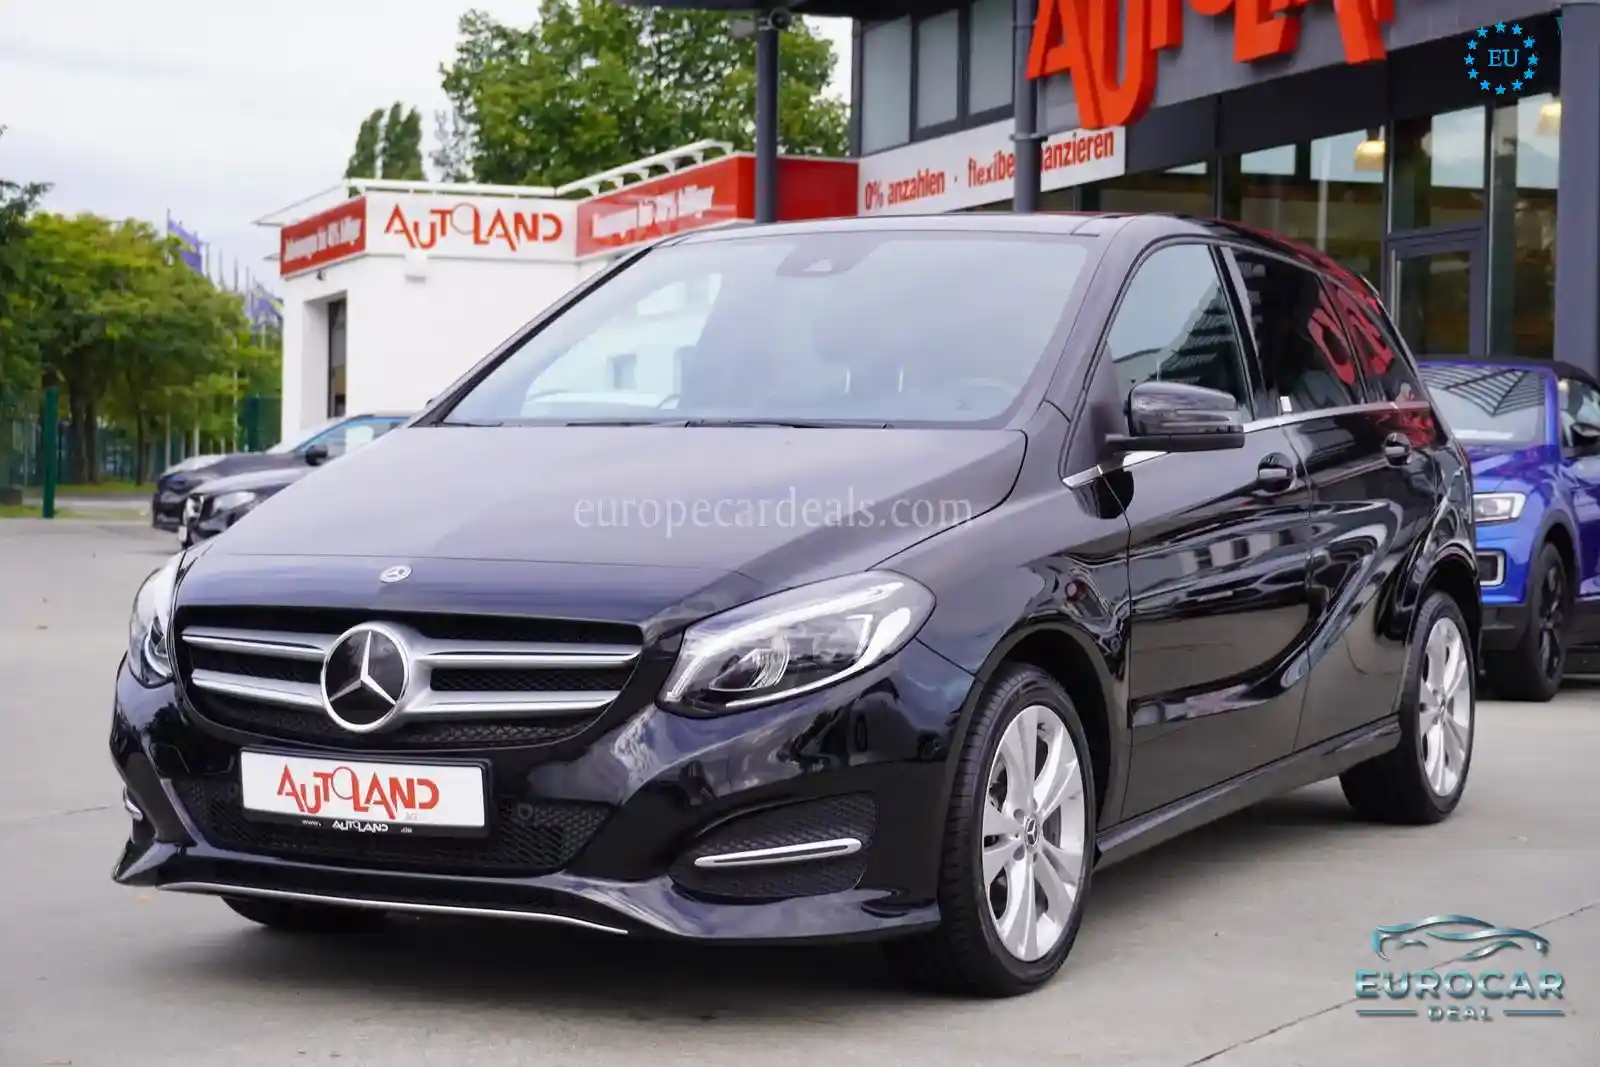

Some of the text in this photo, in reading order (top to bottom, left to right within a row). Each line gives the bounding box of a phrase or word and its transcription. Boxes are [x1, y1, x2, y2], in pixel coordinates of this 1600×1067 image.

[864, 131, 1115, 210] 0% anzahlen flexibe anzieren
